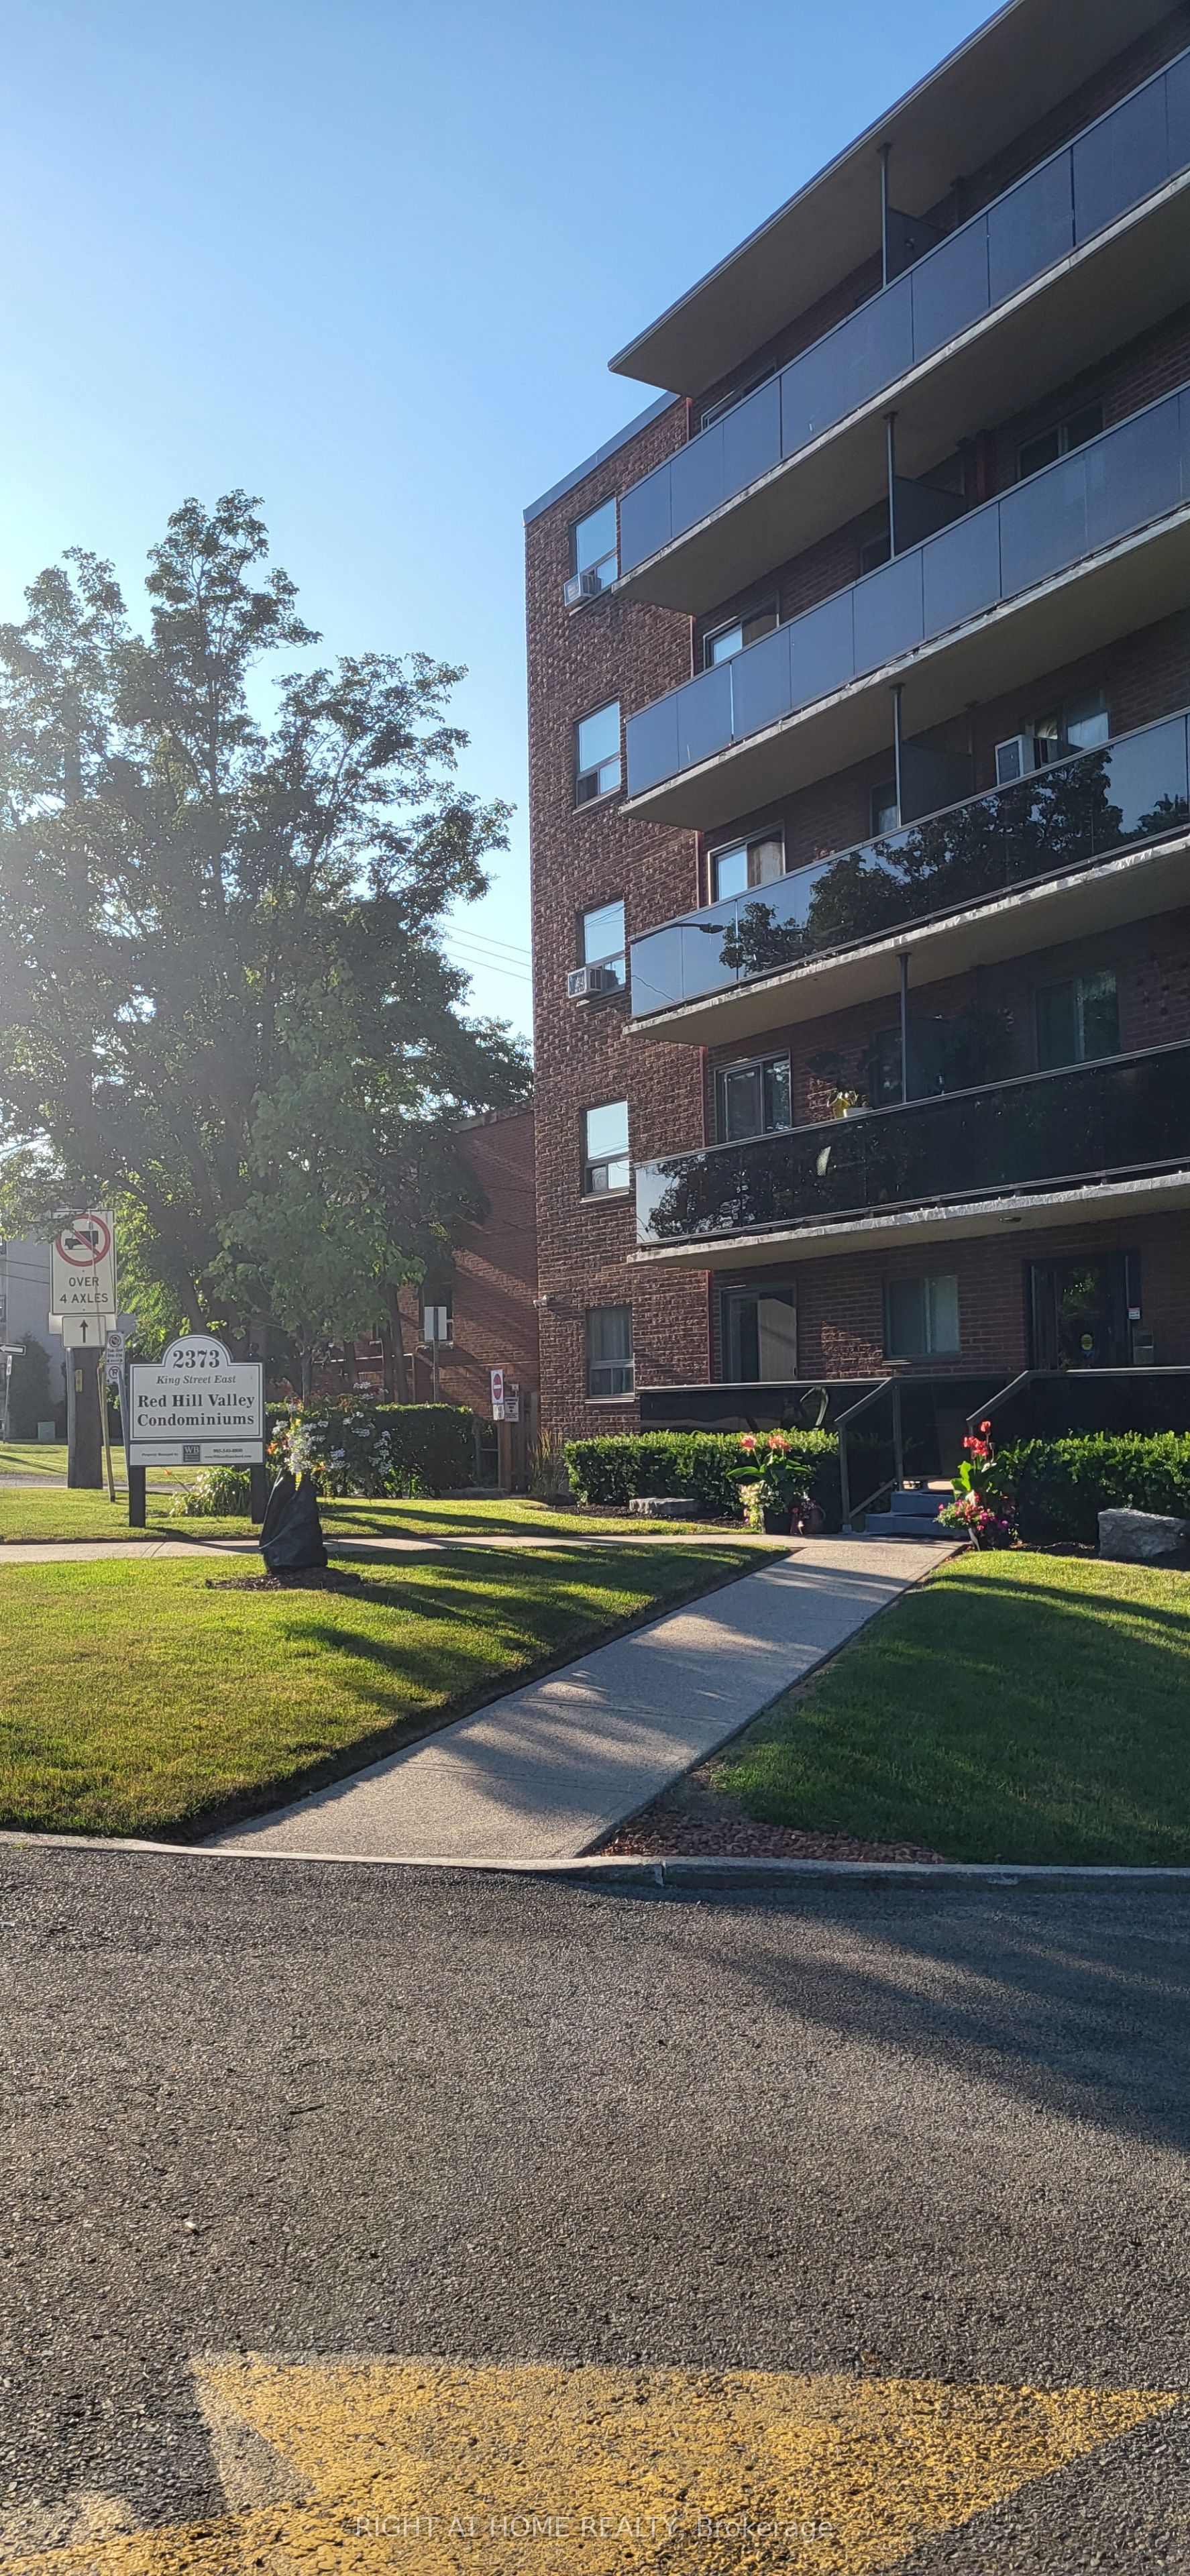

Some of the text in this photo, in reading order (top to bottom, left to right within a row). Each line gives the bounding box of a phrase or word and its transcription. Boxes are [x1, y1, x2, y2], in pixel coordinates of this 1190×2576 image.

[68, 1277, 99, 1287] OVER
[59, 1293, 109, 1304] 4 AXLES
[172, 1350, 220, 1369] 2373
[156, 1375, 237, 1386] King Street East
[138, 1393, 256, 1409] Red Hill Valley
[137, 1412, 255, 1427] Condominiums
[184, 1446, 199, 1454] WB
